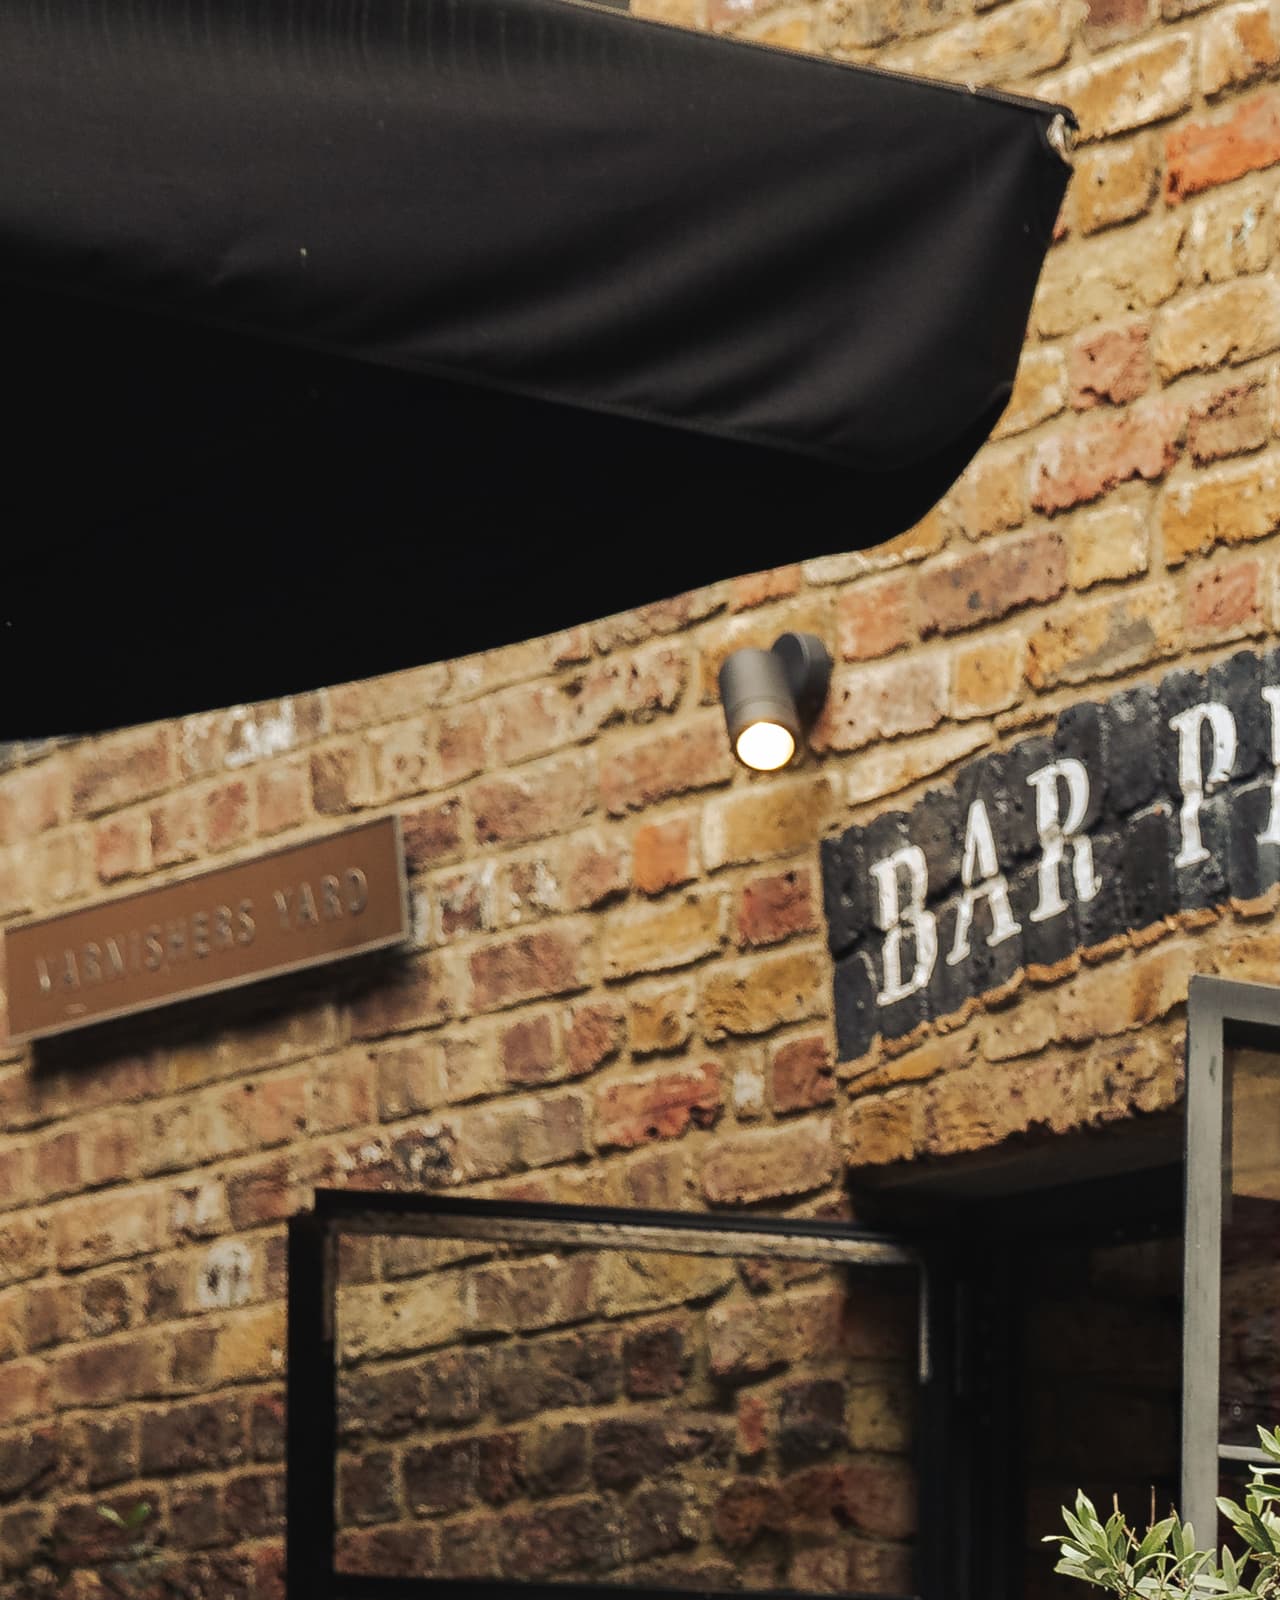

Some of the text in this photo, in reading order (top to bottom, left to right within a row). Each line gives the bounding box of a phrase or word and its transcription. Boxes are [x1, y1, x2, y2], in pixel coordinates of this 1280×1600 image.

[36, 866, 369, 993] VARNISHERS YARD
[869, 758, 1101, 1007] BAR
